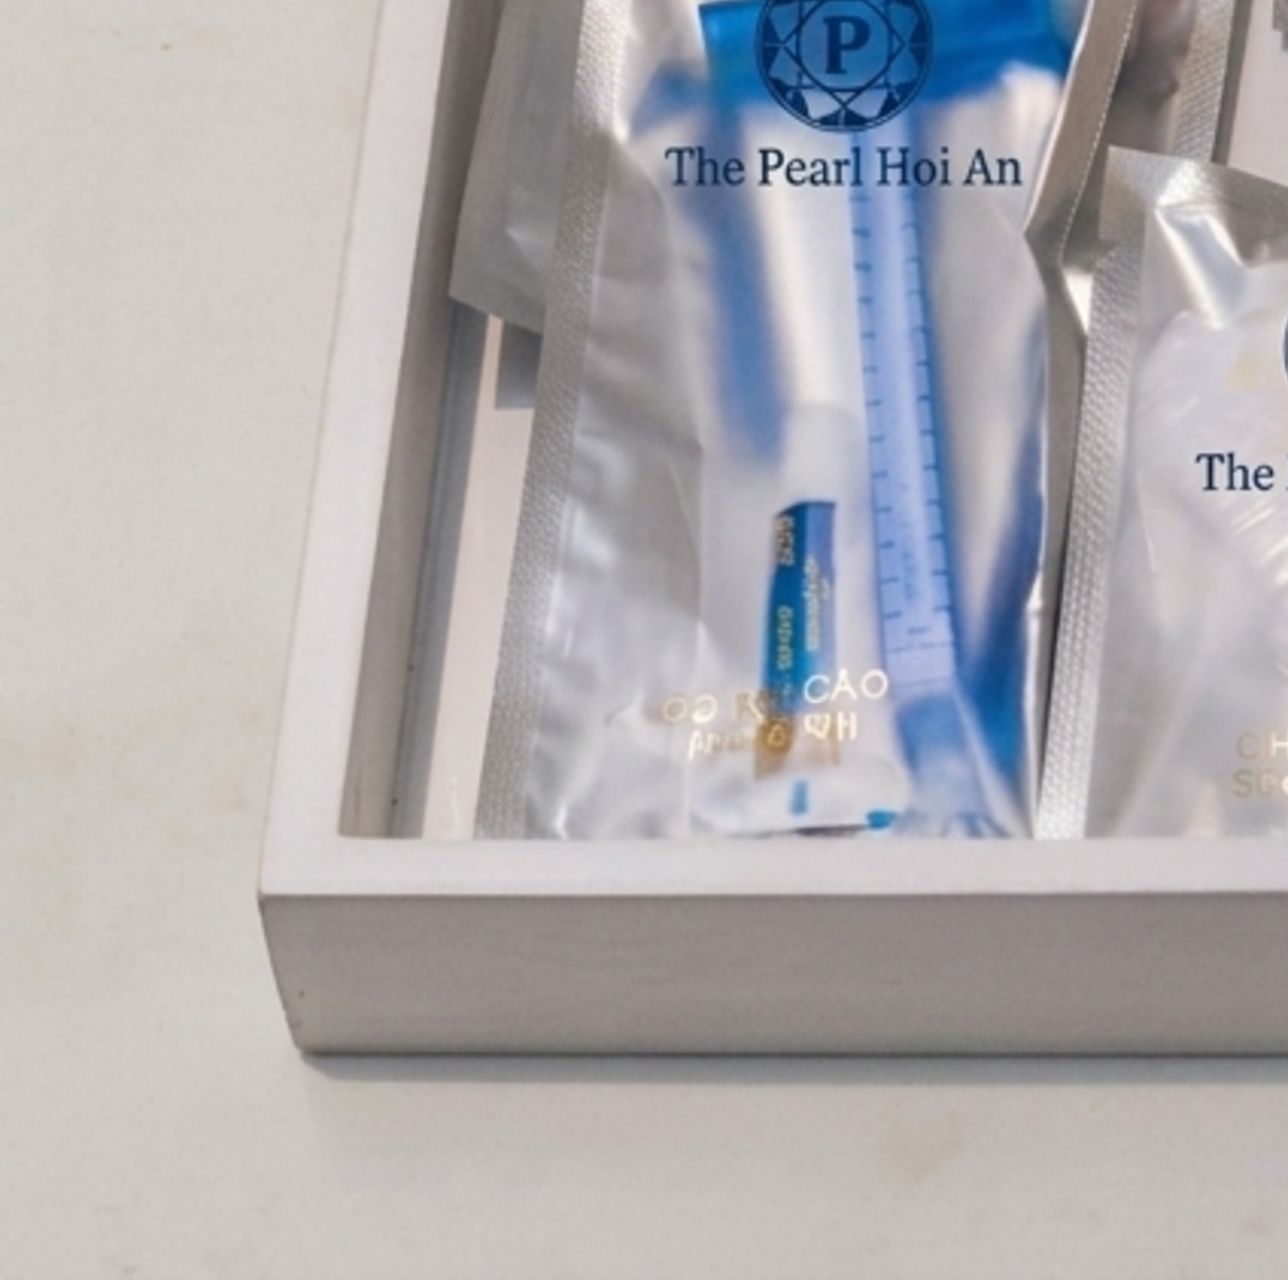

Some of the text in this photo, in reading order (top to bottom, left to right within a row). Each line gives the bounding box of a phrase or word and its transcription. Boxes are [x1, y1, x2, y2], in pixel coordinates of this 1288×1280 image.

[823, 16, 870, 75] P
[664, 145, 1024, 188] The Pearl Hoi An
[1194, 451, 1275, 492] The
